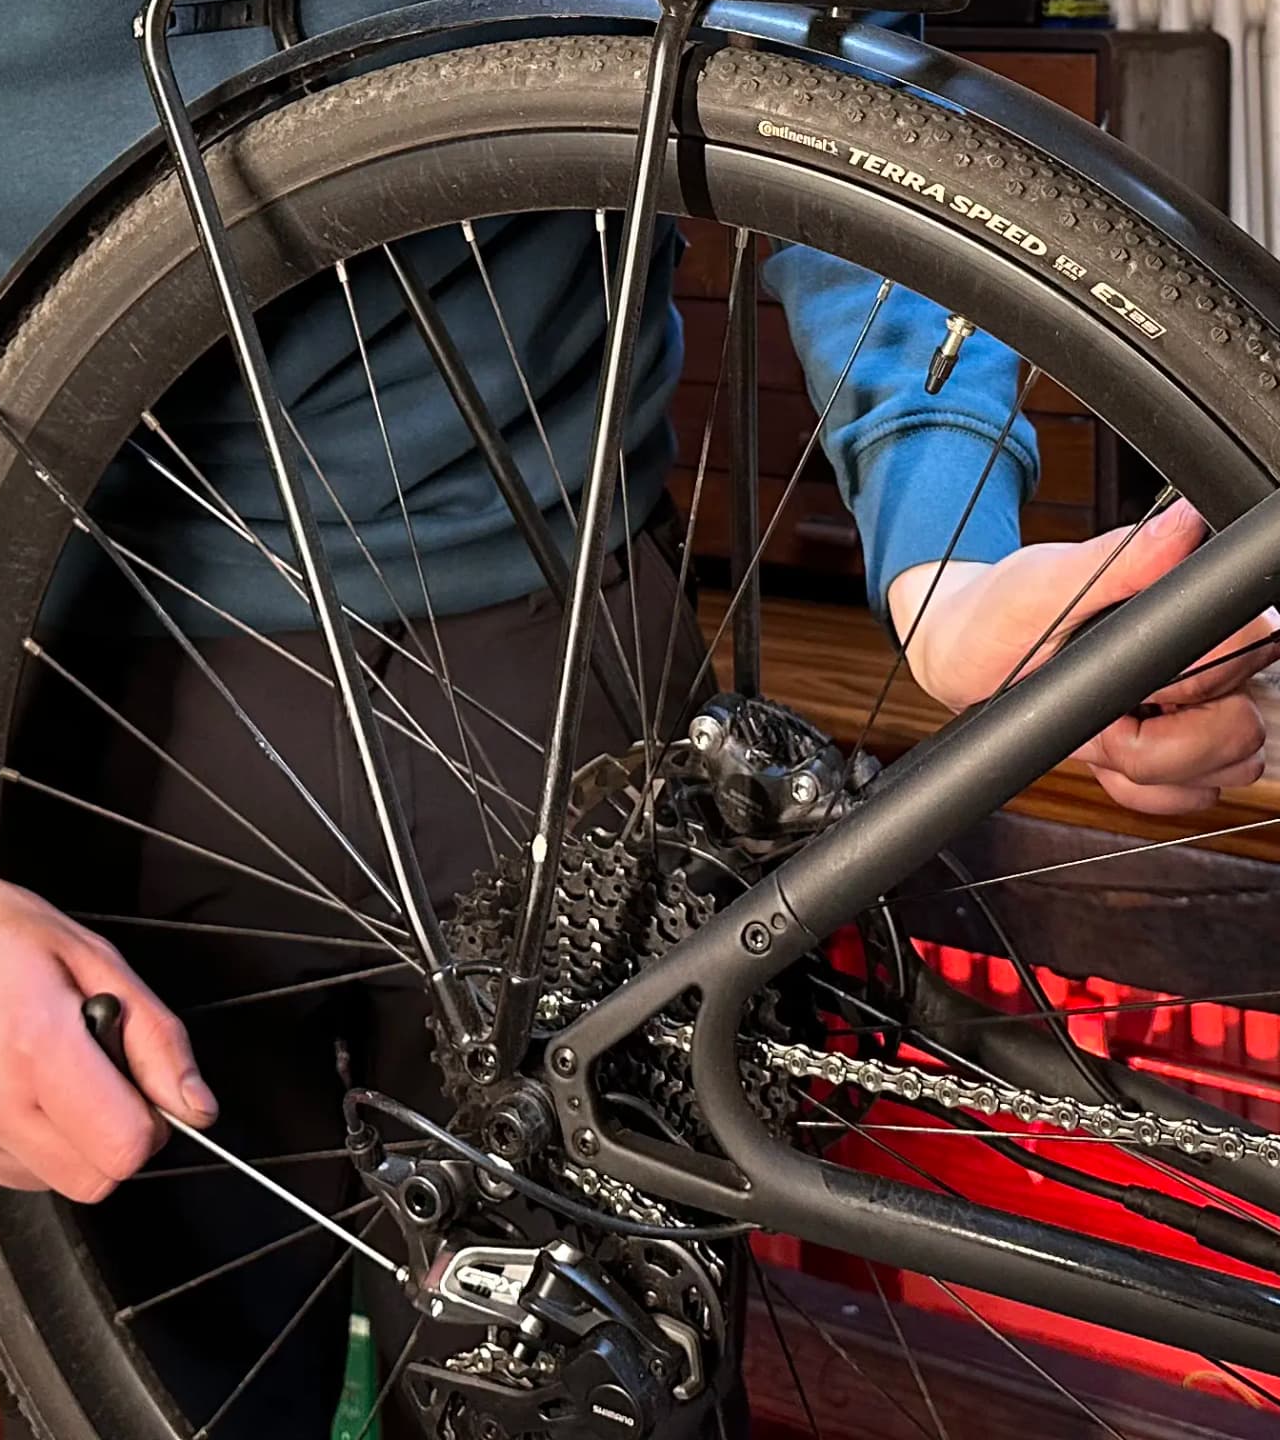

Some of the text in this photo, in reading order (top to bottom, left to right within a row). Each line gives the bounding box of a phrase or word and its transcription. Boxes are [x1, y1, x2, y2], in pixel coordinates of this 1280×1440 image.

[758, 120, 827, 152] Continental
[847, 146, 1048, 257] TERRA SPEED
[456, 1265, 523, 1305] GRX
[592, 1404, 634, 1427] SHIMANO
